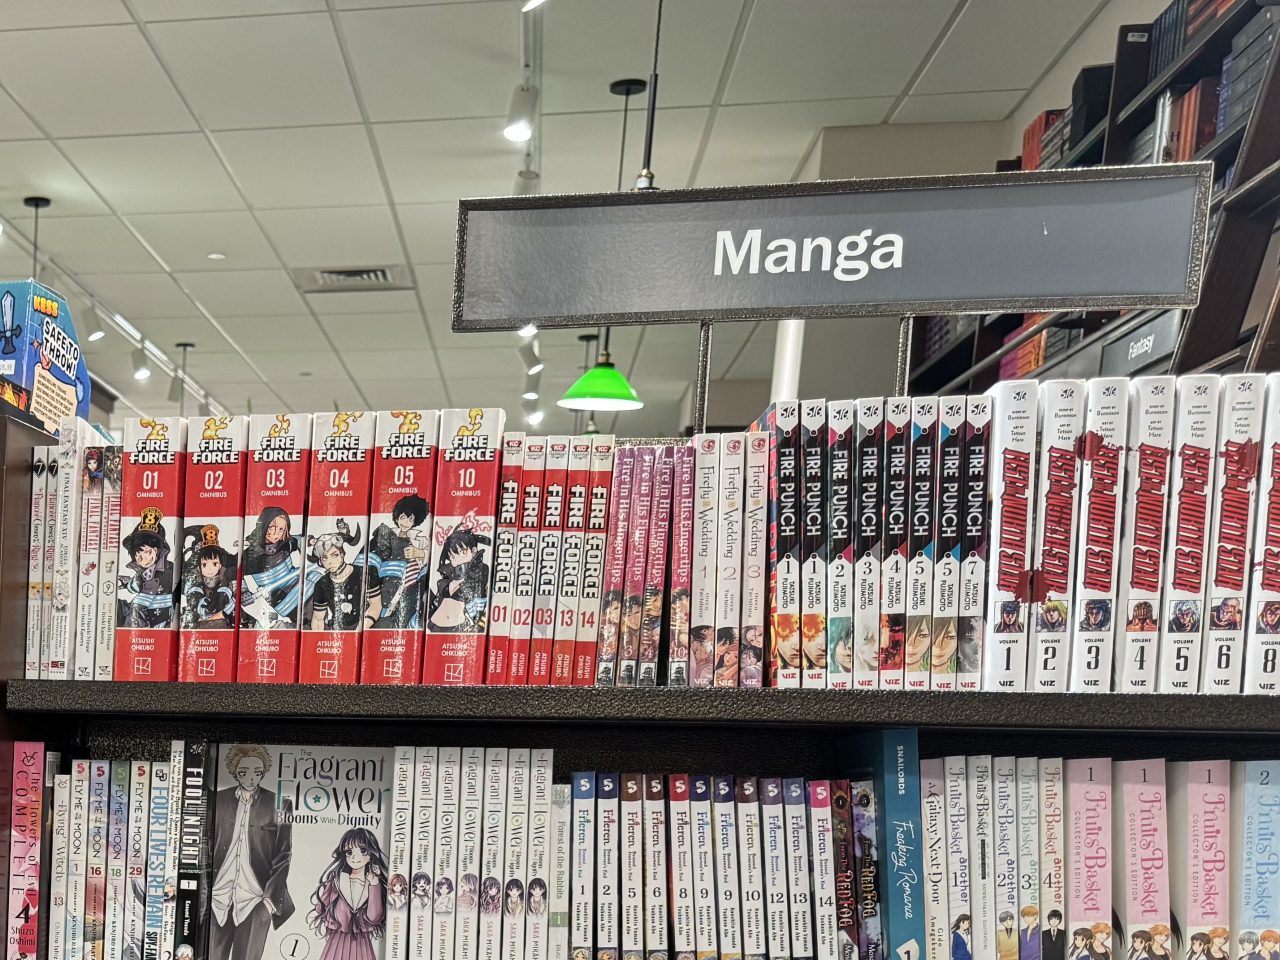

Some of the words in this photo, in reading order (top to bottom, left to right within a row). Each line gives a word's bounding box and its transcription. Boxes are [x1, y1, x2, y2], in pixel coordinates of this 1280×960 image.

[713, 229, 904, 281] Manga
[33, 296, 59, 318] KESS
[45, 321, 66, 346] SAFE
[66, 342, 79, 360] TO
[1128, 333, 1155, 360] Fantasy
[42, 339, 76, 377] THROW!
[137, 439, 169, 452] FIRE
[390, 433, 424, 447] FIRE
[130, 450, 174, 464] FORCE
[381, 445, 431, 459] FORCE
[781, 448, 794, 477] FIRE
[143, 471, 158, 488] 01
[394, 466, 414, 485] 05
[781, 483, 795, 537] PUNCH
[785, 561, 791, 574] 1
[131, 644, 154, 652] OHKUBO
[1086, 646, 1099, 670] 3
[1004, 647, 1011, 671] 1
[1175, 647, 1189, 671] 5
[300, 749, 313, 757] The
[278, 753, 386, 787] Fragrant
[896, 745, 905, 795] SNAILORDS
[1088, 767, 1093, 782] 1
[276, 811, 318, 824] Blooms
[338, 813, 381, 829] Dignity
[1084, 790, 1107, 848] Fruits
[892, 820, 914, 872] Freaking
[90, 867, 101, 876] 16
[1083, 846, 1107, 915] Basket
[580, 885, 585, 895] 1
[896, 869, 917, 919] Romance
[15, 902, 31, 923] 4
[289, 939, 298, 957] 1
[904, 949, 911, 960] 1
